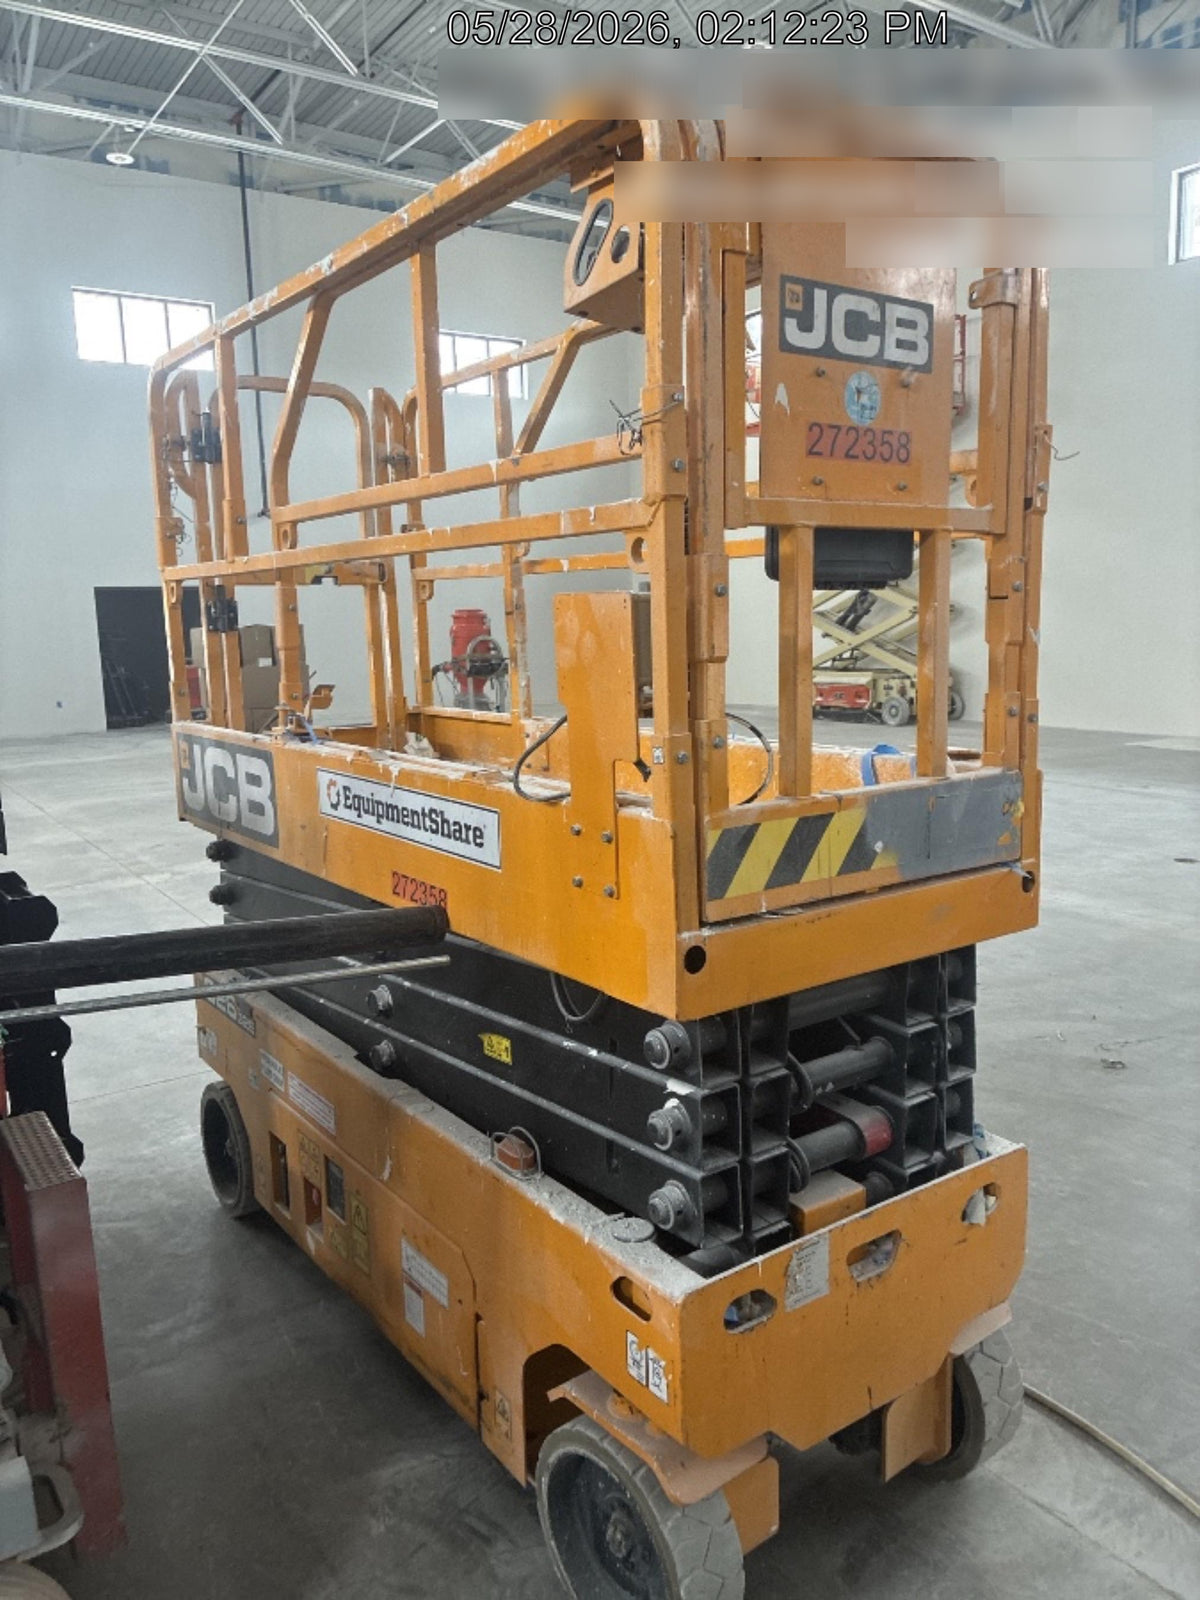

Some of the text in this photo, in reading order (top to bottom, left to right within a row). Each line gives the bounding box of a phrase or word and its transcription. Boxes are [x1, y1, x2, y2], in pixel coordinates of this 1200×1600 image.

[784, 287, 929, 365] JCB
[808, 422, 911, 463] 272358
[182, 743, 275, 836] JCB
[343, 785, 484, 848] EquipmentShare
[392, 871, 447, 908] 272358
